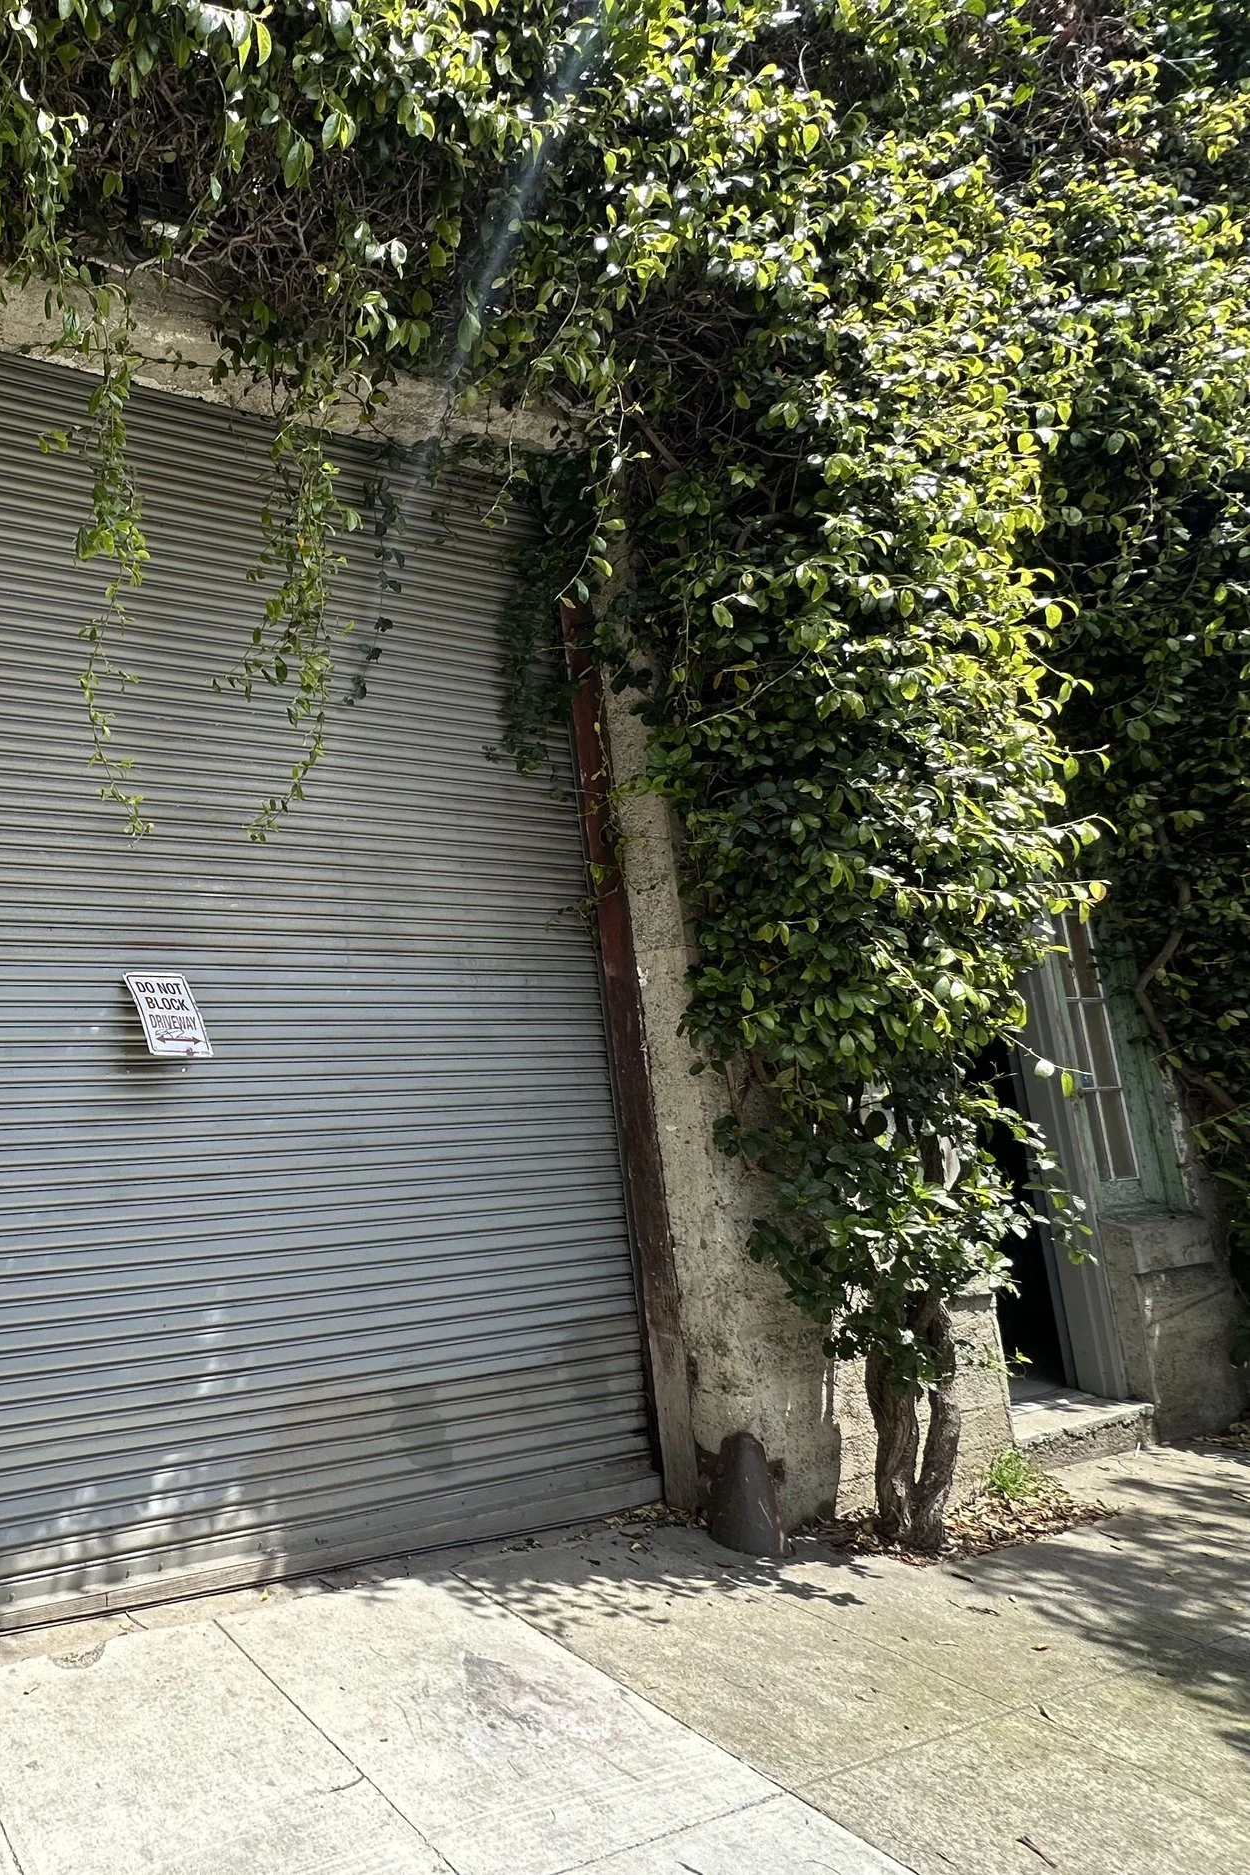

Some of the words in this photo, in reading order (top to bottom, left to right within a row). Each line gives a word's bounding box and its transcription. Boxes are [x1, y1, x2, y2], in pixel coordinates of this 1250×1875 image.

[135, 981, 155, 993] DO
[156, 982, 182, 995] NOT
[145, 996, 190, 1011] BLOCK
[149, 1014, 197, 1030] DRIVEWAY
